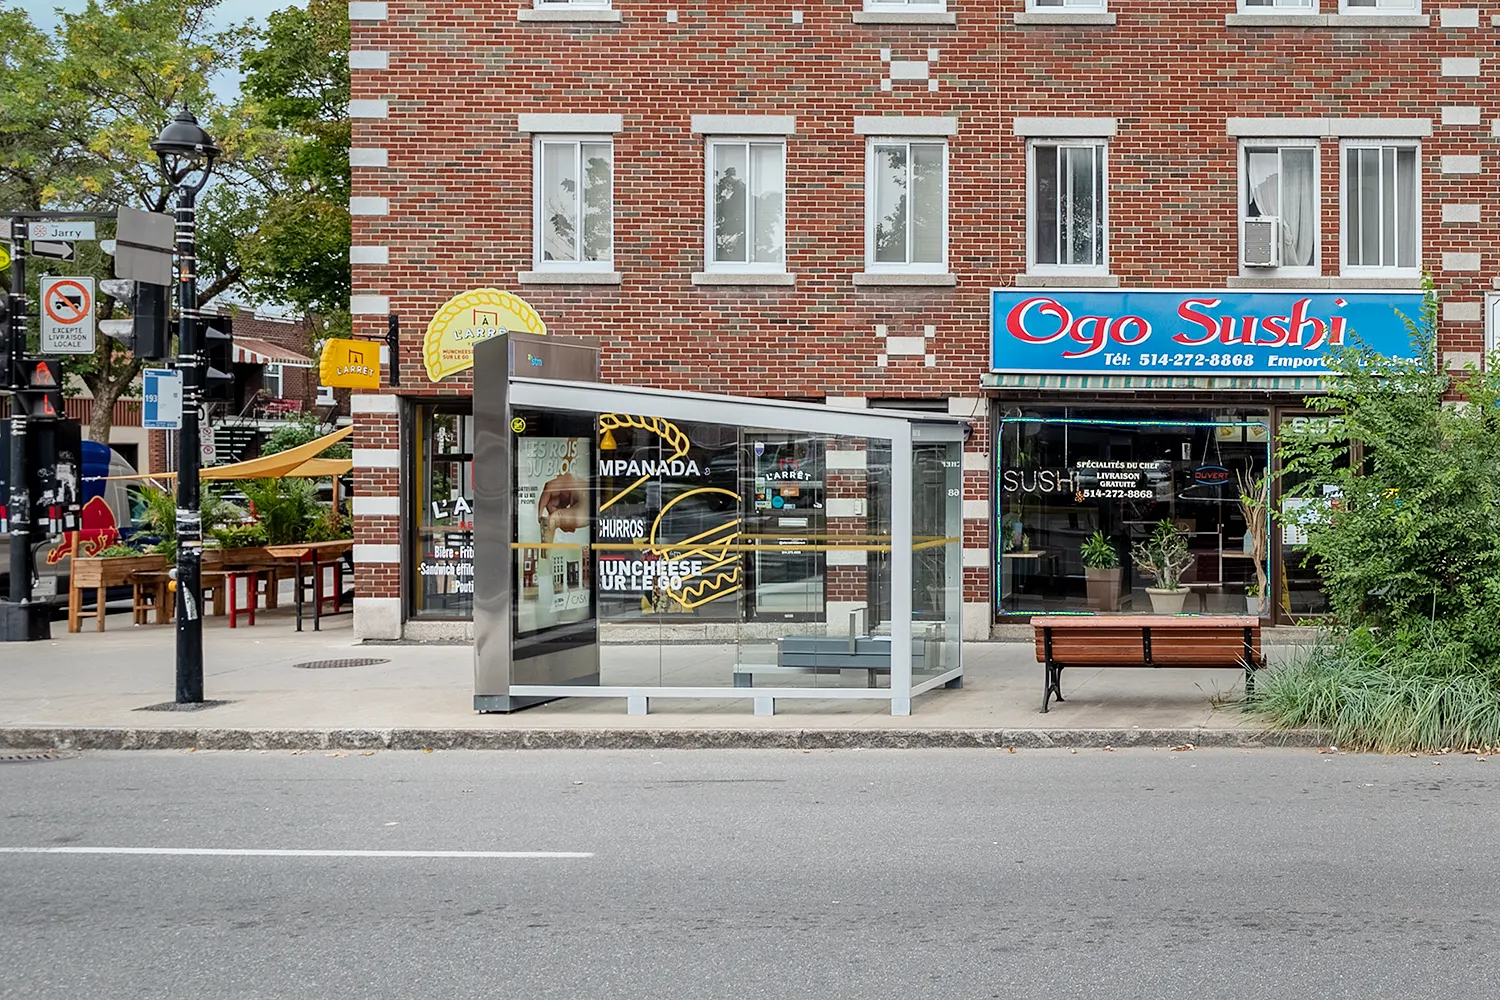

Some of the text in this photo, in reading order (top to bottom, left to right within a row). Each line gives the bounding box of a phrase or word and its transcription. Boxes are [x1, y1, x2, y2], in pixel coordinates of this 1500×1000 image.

[51, 228, 82, 239] Jarry
[1006, 297, 1348, 358] Ogo Sushi
[53, 340, 82, 348] LOCALE
[1103, 352, 1131, 367] Tél:
[1138, 352, 1254, 368] 514-272-8868
[145, 393, 158, 403] 193
[1076, 460, 1125, 470] SPÉCIALITÉS
[1140, 462, 1160, 470] CHEF
[1096, 472, 1140, 480] LIVRAISON
[1195, 471, 1229, 480] OUVERT
[1099, 480, 1137, 488] GRATUITE
[1083, 488, 1153, 498] 514-272-8868
[420, 561, 455, 576] Sandwich
[599, 575, 682, 591] UR LE GO
